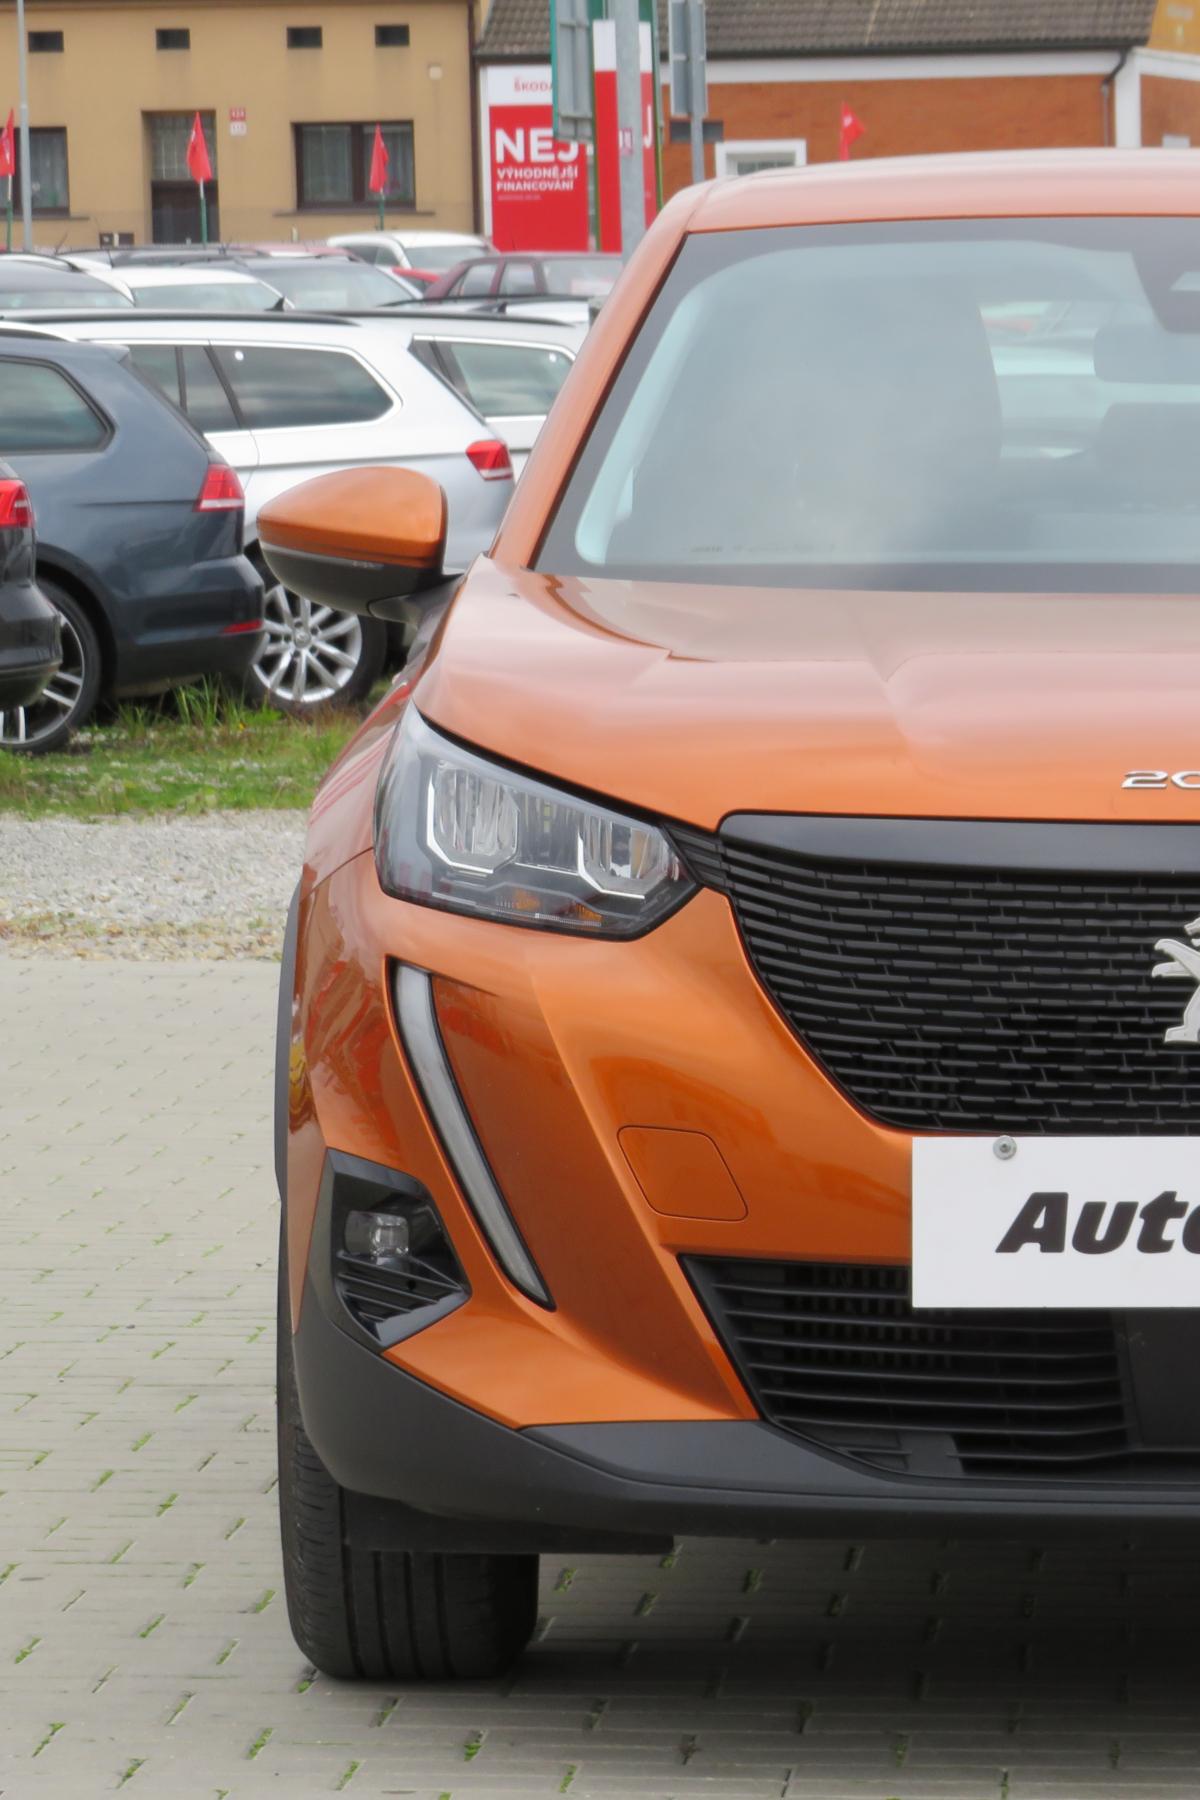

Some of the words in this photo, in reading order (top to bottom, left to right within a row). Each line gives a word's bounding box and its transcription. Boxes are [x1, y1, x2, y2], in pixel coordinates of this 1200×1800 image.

[495, 128, 579, 163] NEJ
[497, 165, 578, 180] VÝHODNĚJŠÍ
[497, 179, 574, 192] FINANCOVÁNÍ
